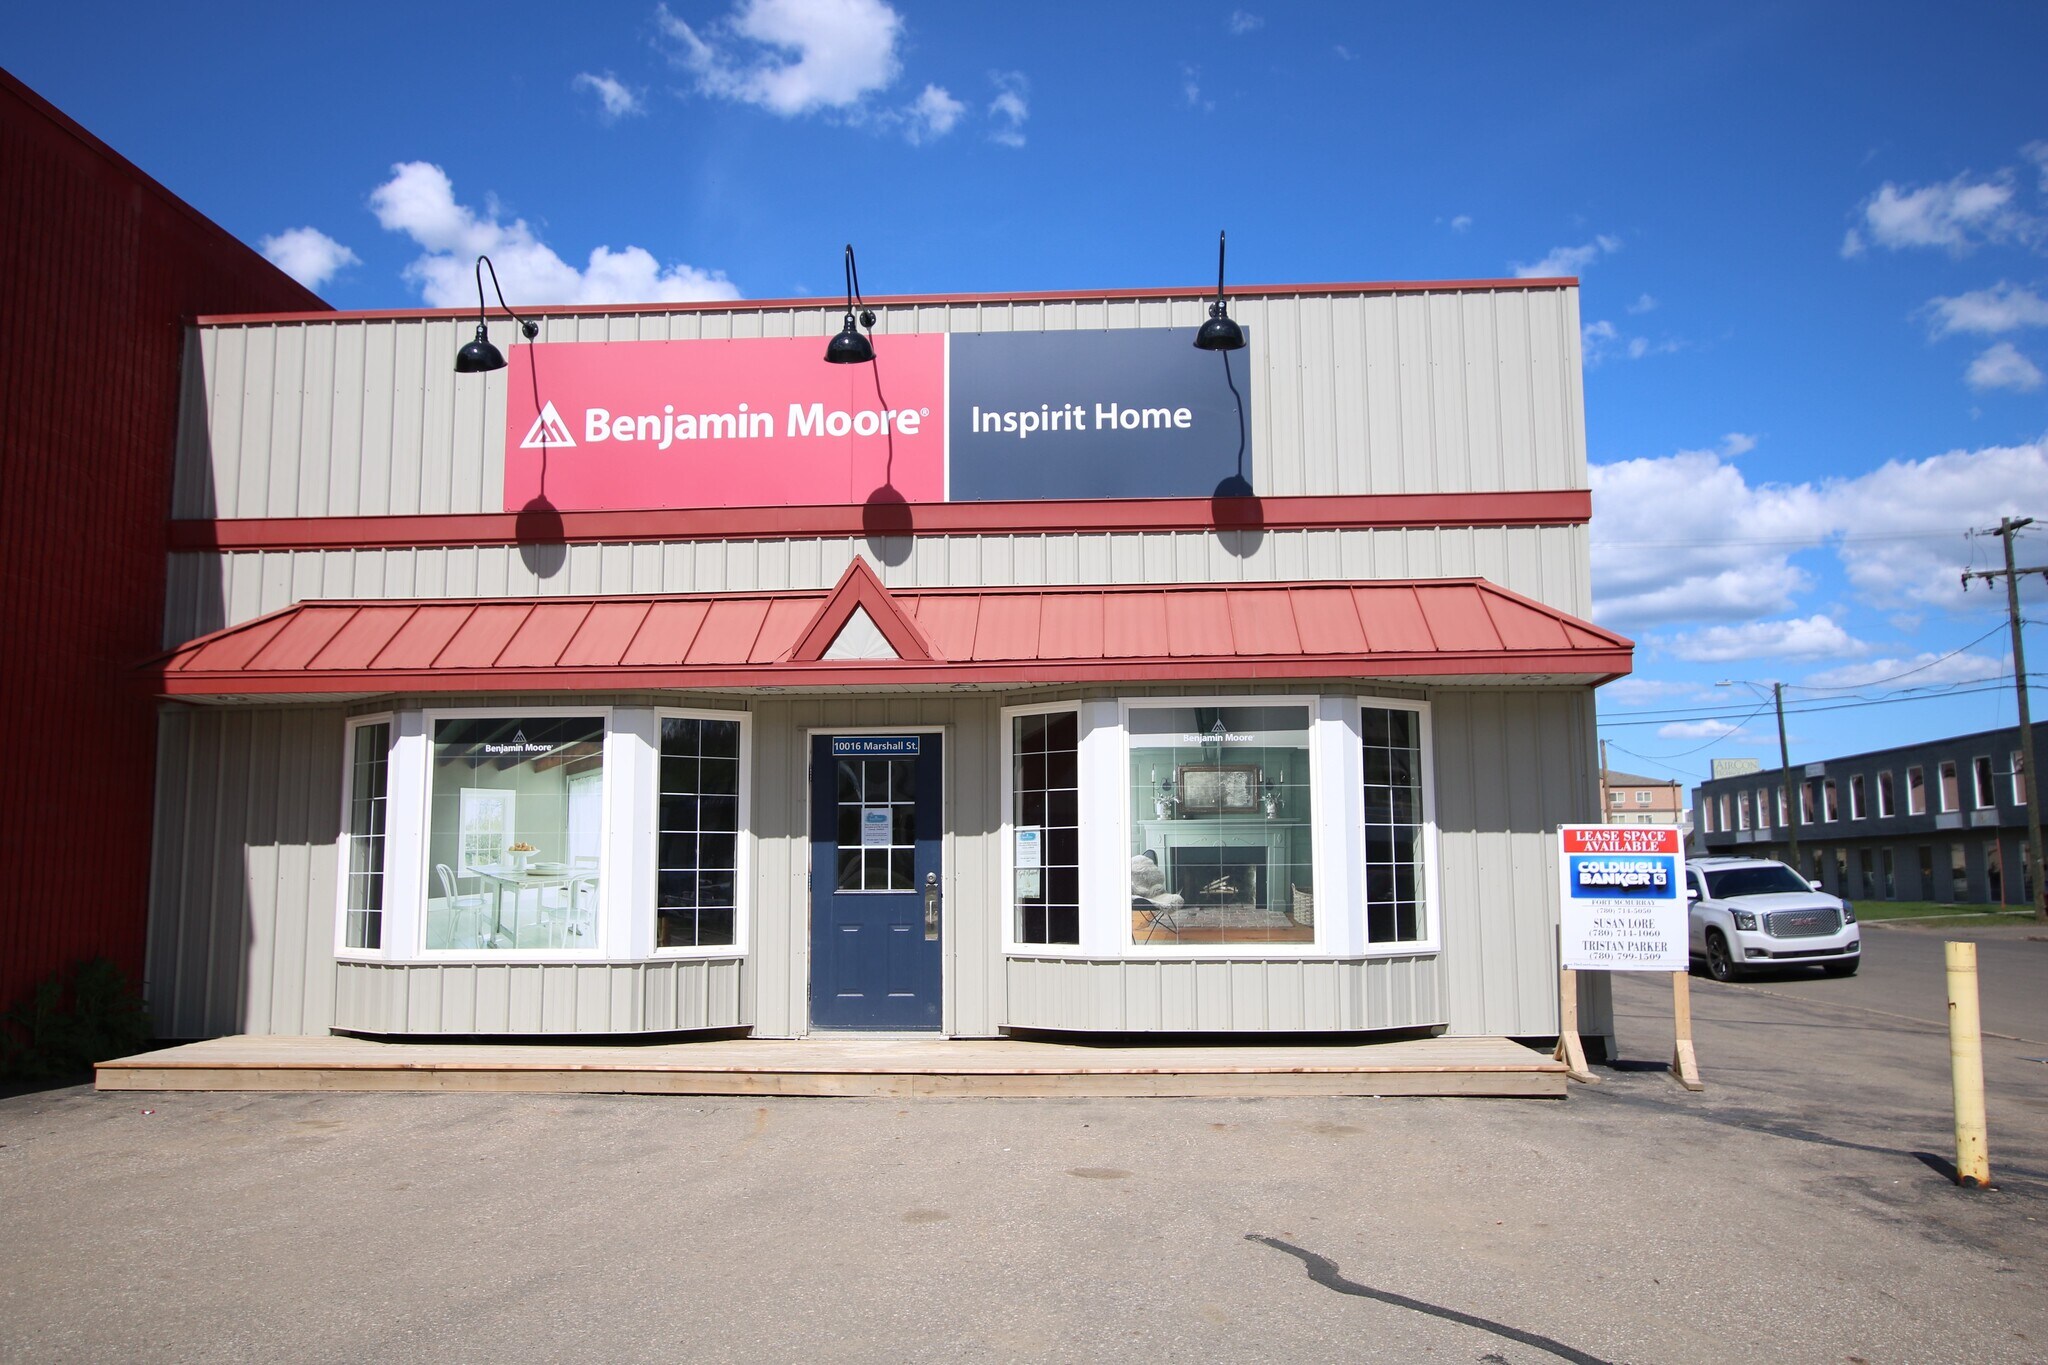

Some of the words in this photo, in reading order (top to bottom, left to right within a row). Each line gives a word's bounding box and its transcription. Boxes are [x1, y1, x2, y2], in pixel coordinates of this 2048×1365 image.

[972, 403, 1086, 438] Inspirit
[1095, 402, 1193, 430] Home
[585, 402, 774, 450] Benjamin
[1183, 733, 1223, 743] Benjamin
[485, 743, 524, 754] Benjamin
[834, 742, 861, 751] 10016
[863, 741, 904, 750] Marshall
[906, 741, 918, 750] St.
[1576, 831, 1620, 841] LEASE
[1623, 831, 1666, 841] SPACE
[1583, 841, 1660, 851] AVAILABLE
[1593, 918, 1625, 929] SUSAN
[1628, 918, 1656, 929] LORE
[1588, 929, 1614, 938] (780)
[1582, 940, 1625, 951] TRISTAN
[1627, 941, 1668, 952] PARKER
[1589, 951, 1614, 960] (780)
[1617, 952, 1662, 960] 799-1509
